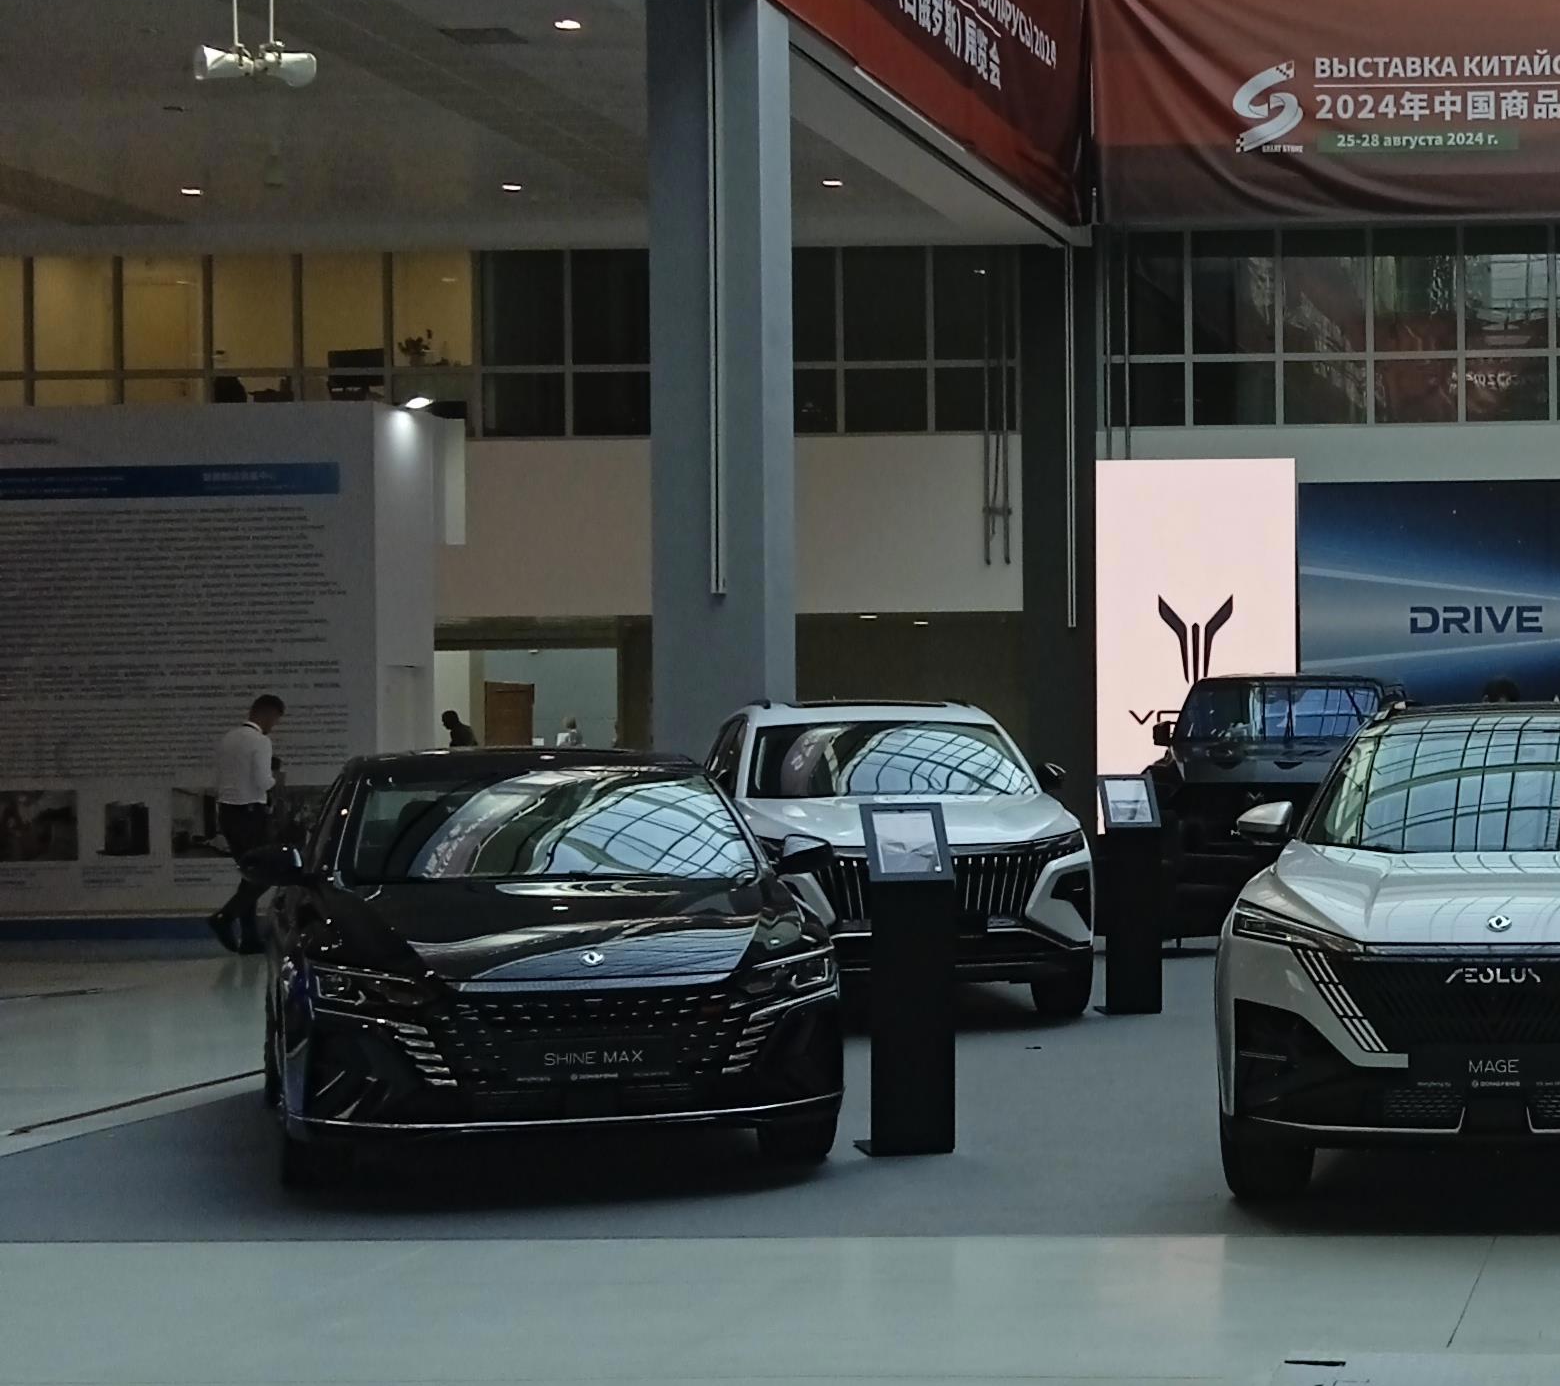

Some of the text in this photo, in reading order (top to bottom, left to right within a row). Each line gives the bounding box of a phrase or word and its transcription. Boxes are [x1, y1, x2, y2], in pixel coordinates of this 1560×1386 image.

[1033, 24, 1057, 70] 2024
[1314, 55, 1458, 79] ВЫСТАВКА
[1336, 131, 1499, 150] 25-28 августа 2024 г.
[1409, 605, 1544, 634] DRIVE
[543, 1049, 644, 1067] SHINE MAX
[1468, 1059, 1520, 1074] MAGE
